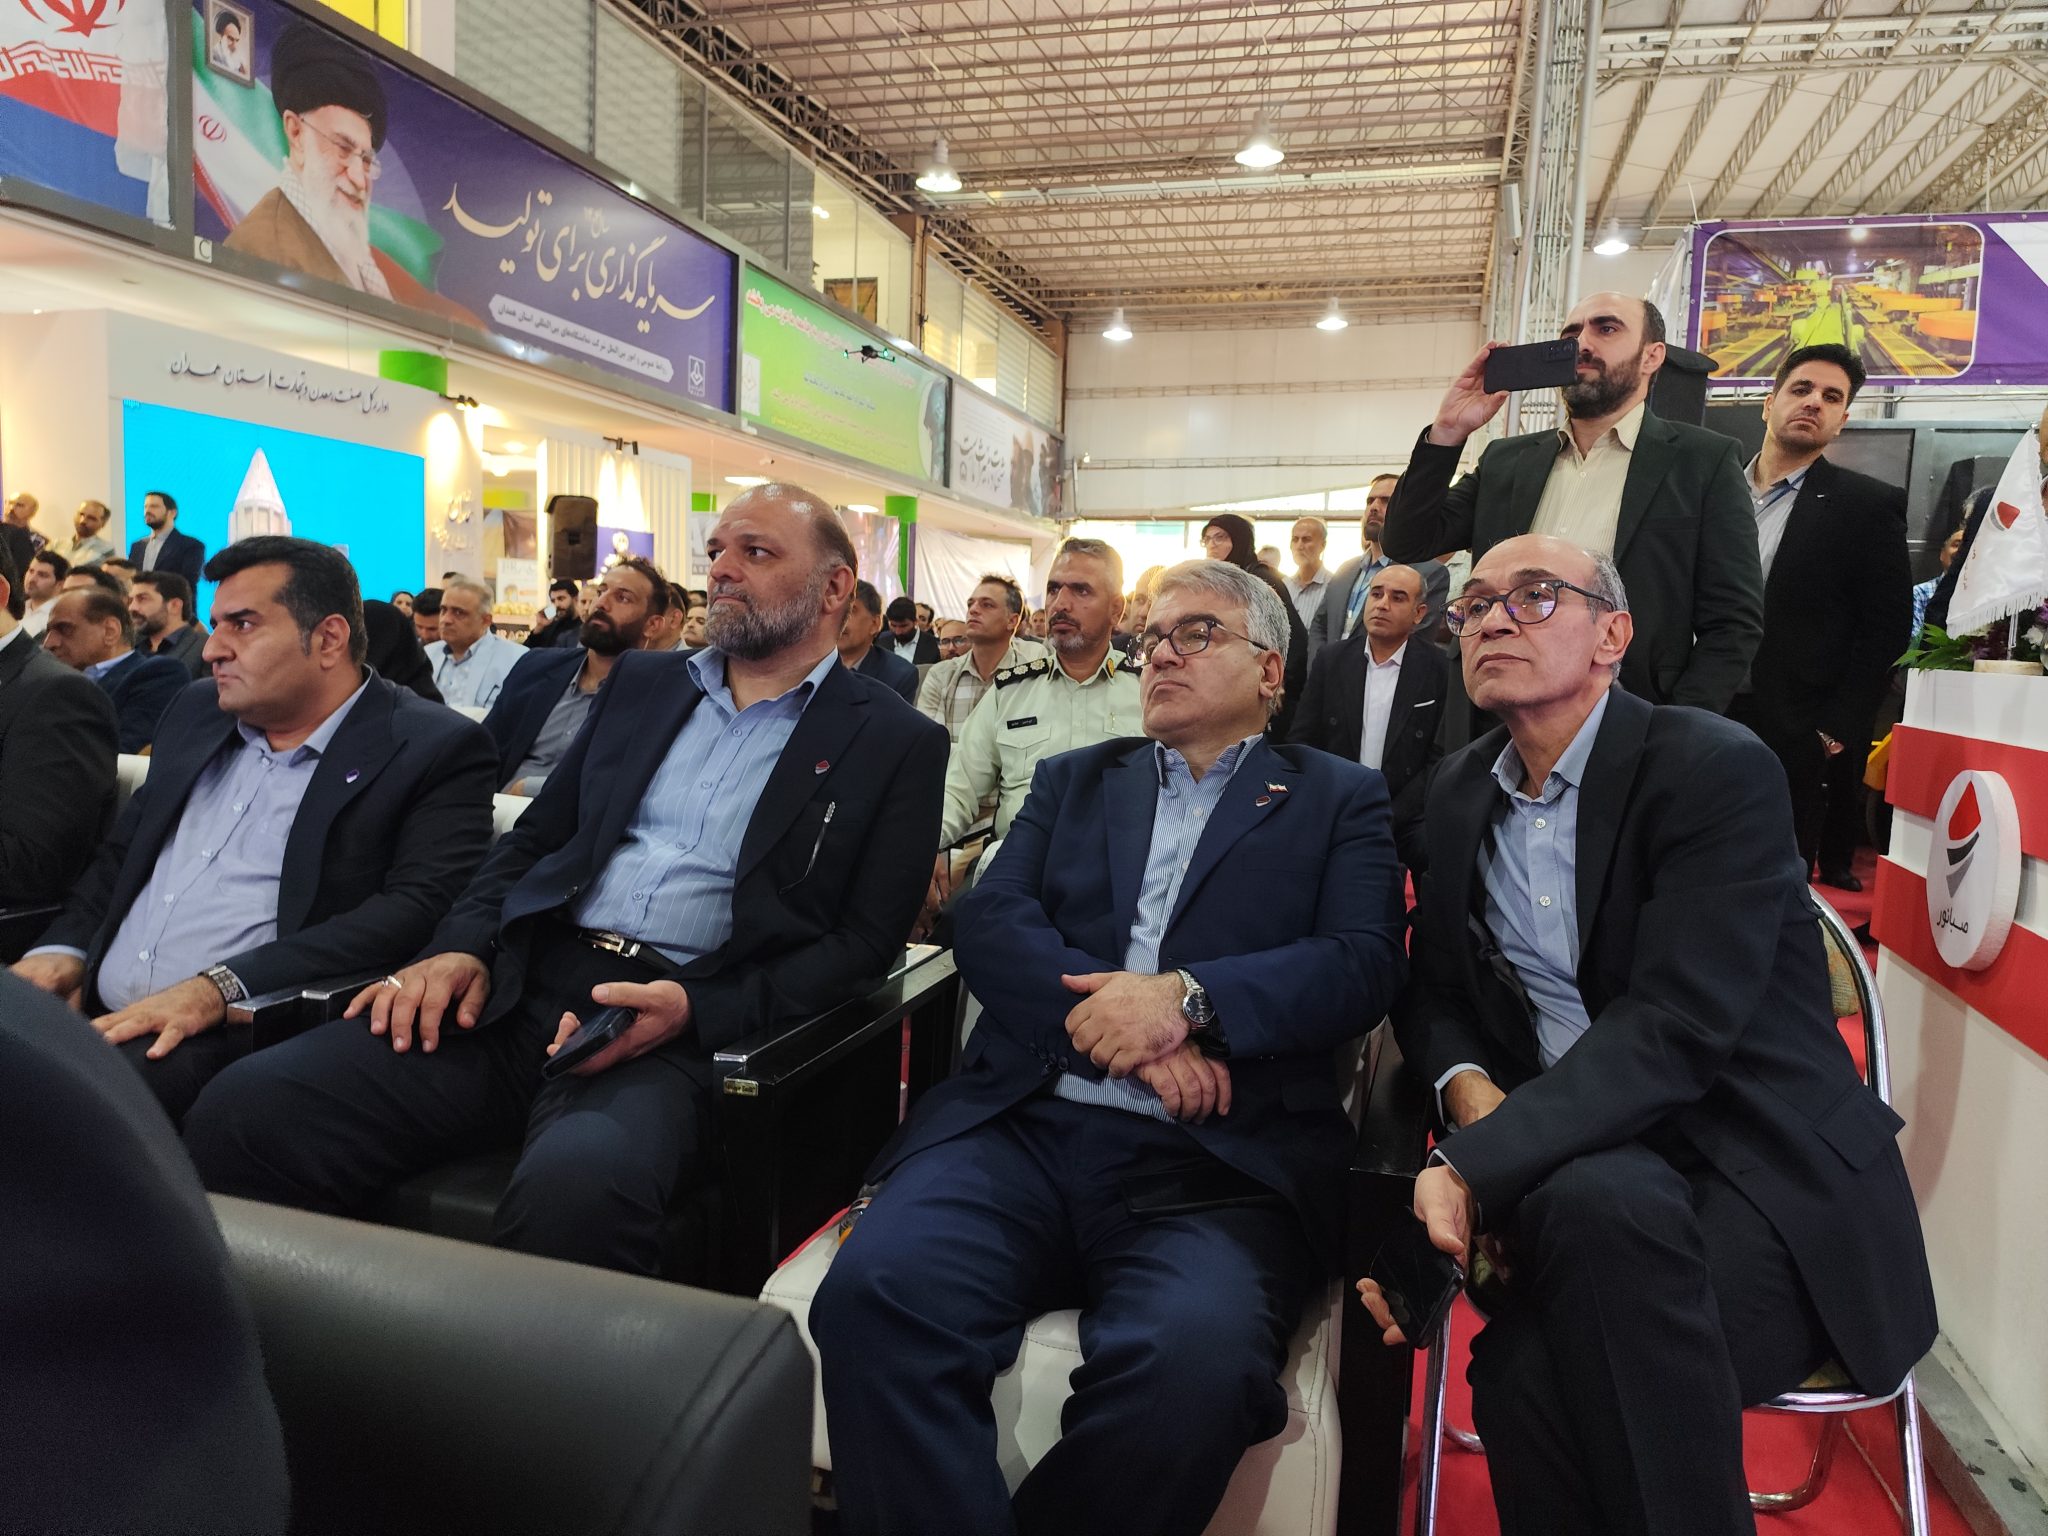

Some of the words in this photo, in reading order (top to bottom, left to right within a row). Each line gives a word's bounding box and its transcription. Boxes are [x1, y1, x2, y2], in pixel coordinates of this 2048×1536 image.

[442, 182, 553, 275] تولید
[536, 224, 587, 302] برای
[170, 352, 221, 376] همدان
[223, 368, 273, 388] استان
[1937, 907, 1969, 934] صبانور
